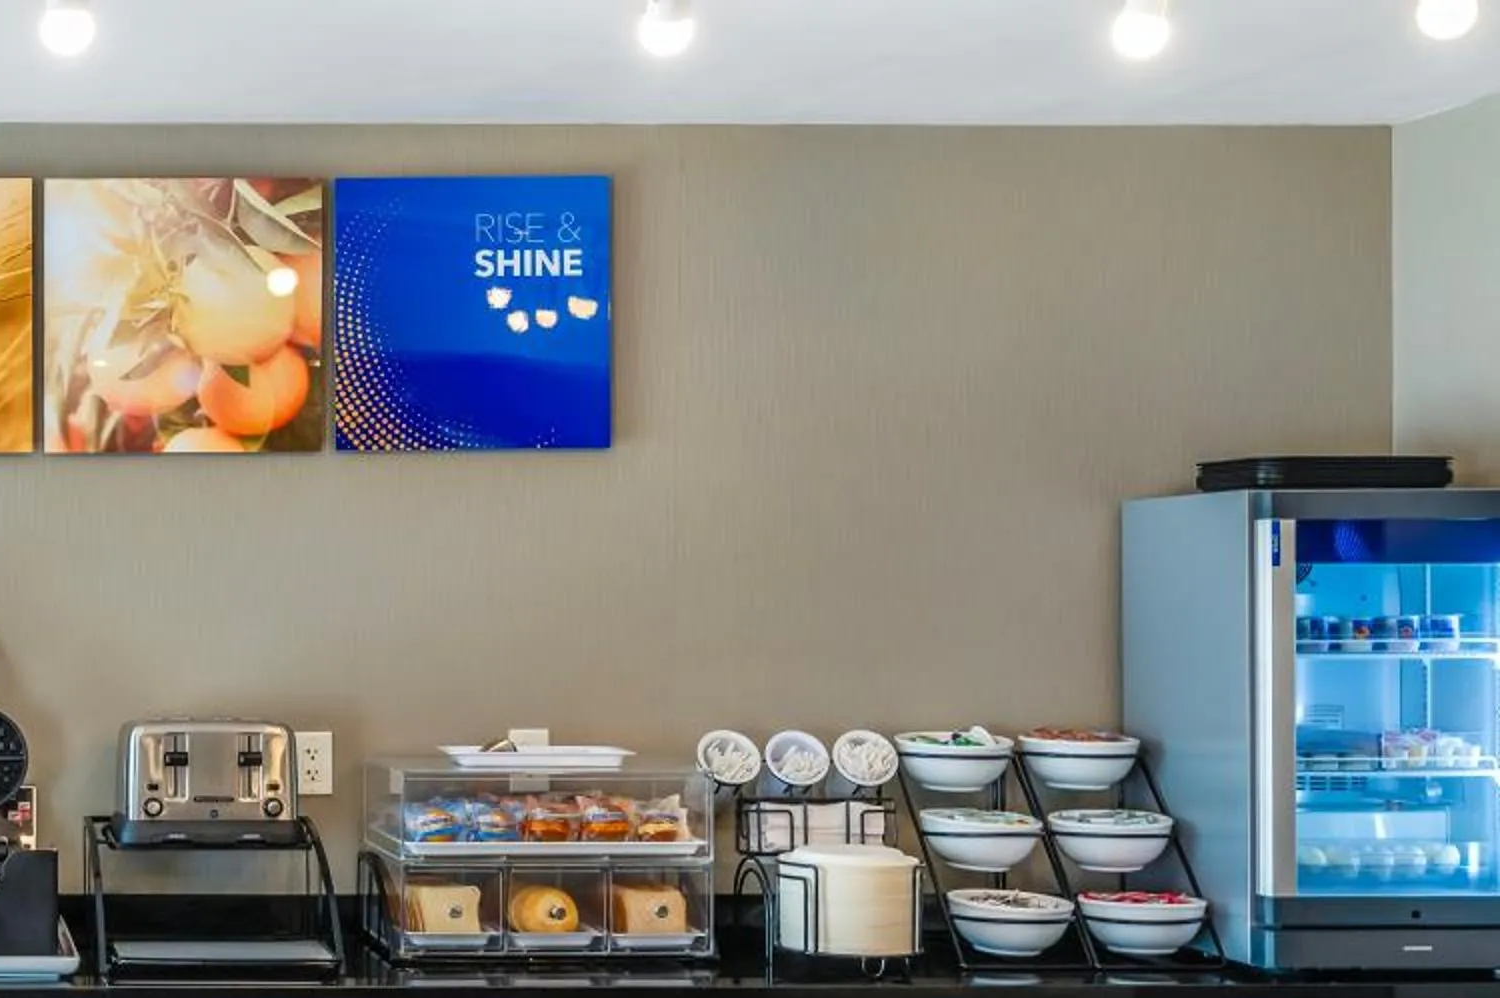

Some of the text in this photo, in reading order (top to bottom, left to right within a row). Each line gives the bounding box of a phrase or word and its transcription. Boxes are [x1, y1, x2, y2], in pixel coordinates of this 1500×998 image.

[475, 211, 582, 243] RISE &
[474, 248, 584, 278] SHINE
